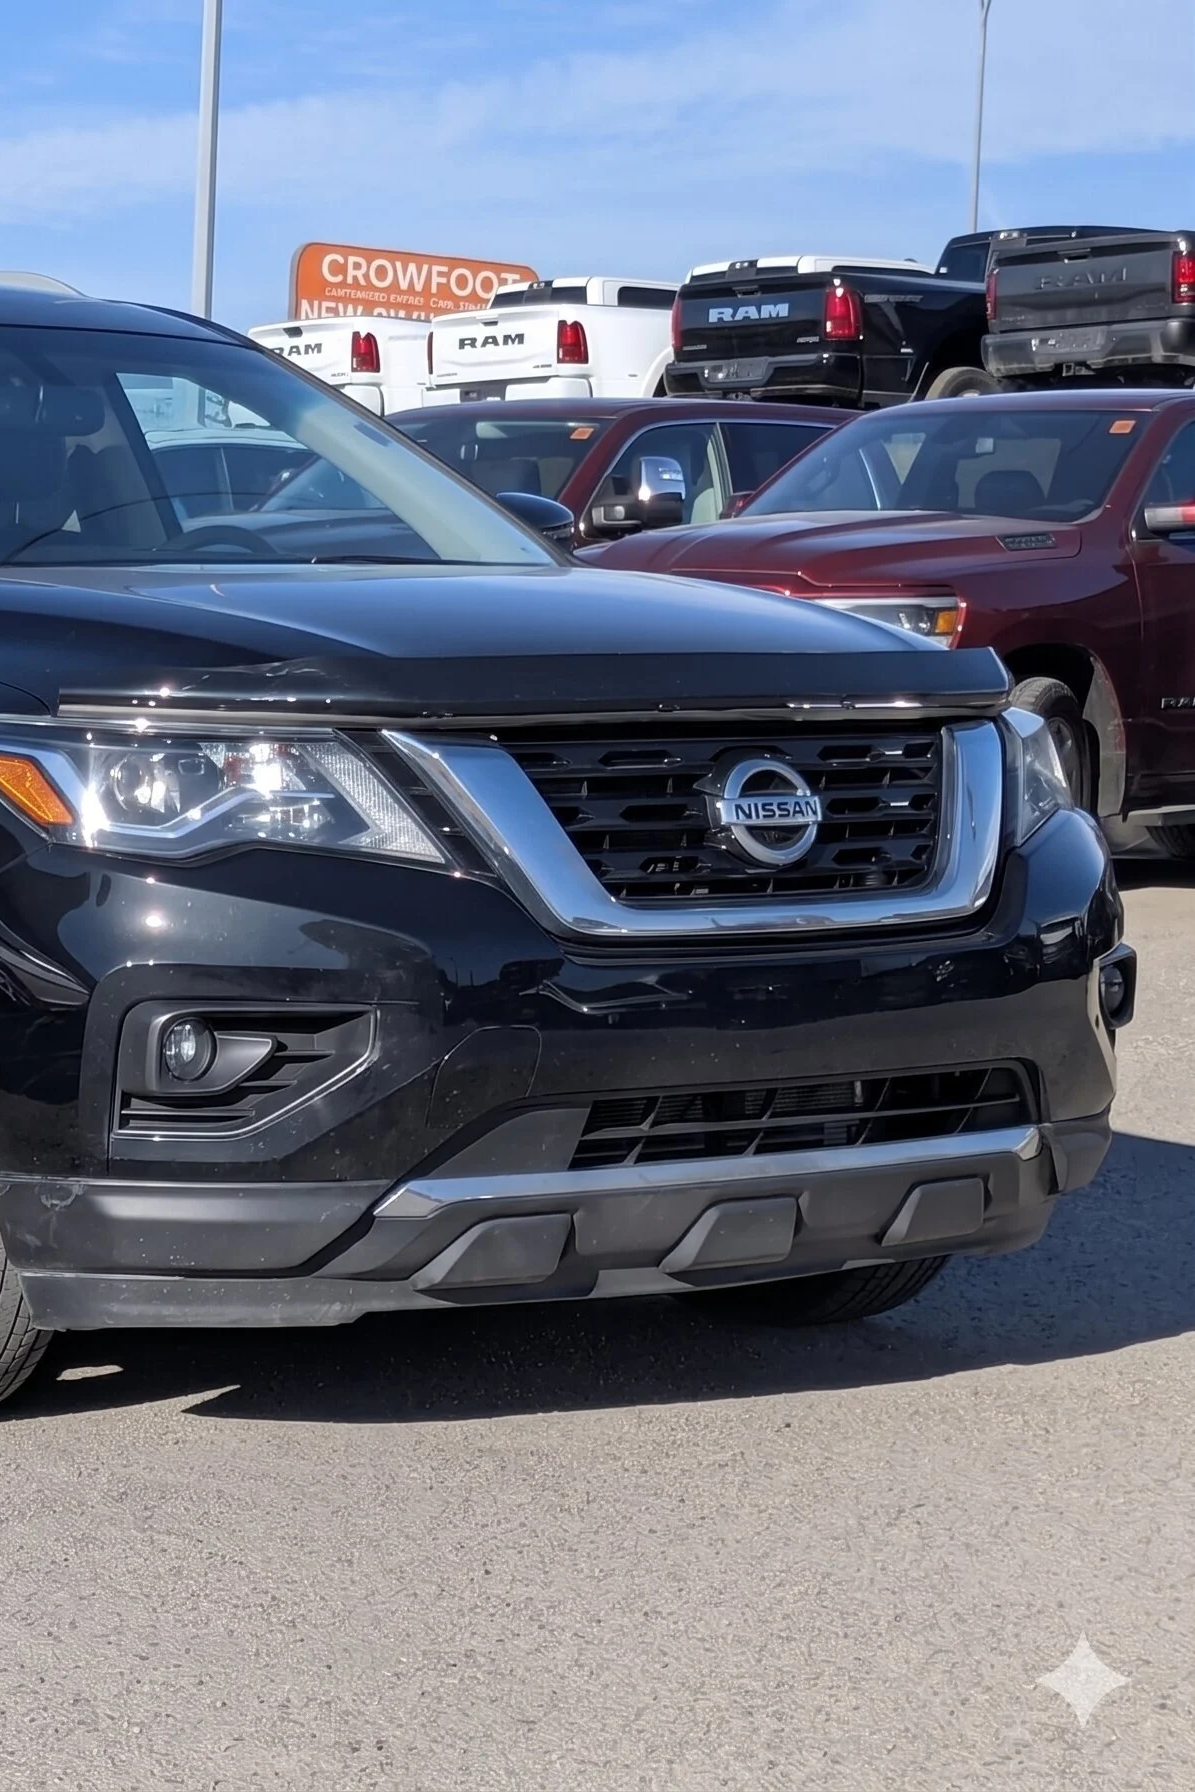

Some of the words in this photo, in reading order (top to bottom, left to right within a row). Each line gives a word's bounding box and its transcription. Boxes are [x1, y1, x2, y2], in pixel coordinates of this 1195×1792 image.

[708, 303, 789, 323] RAM
[458, 333, 525, 350] RAM
[1161, 697, 1195, 709] RA
[734, 800, 818, 820] NISSAN
